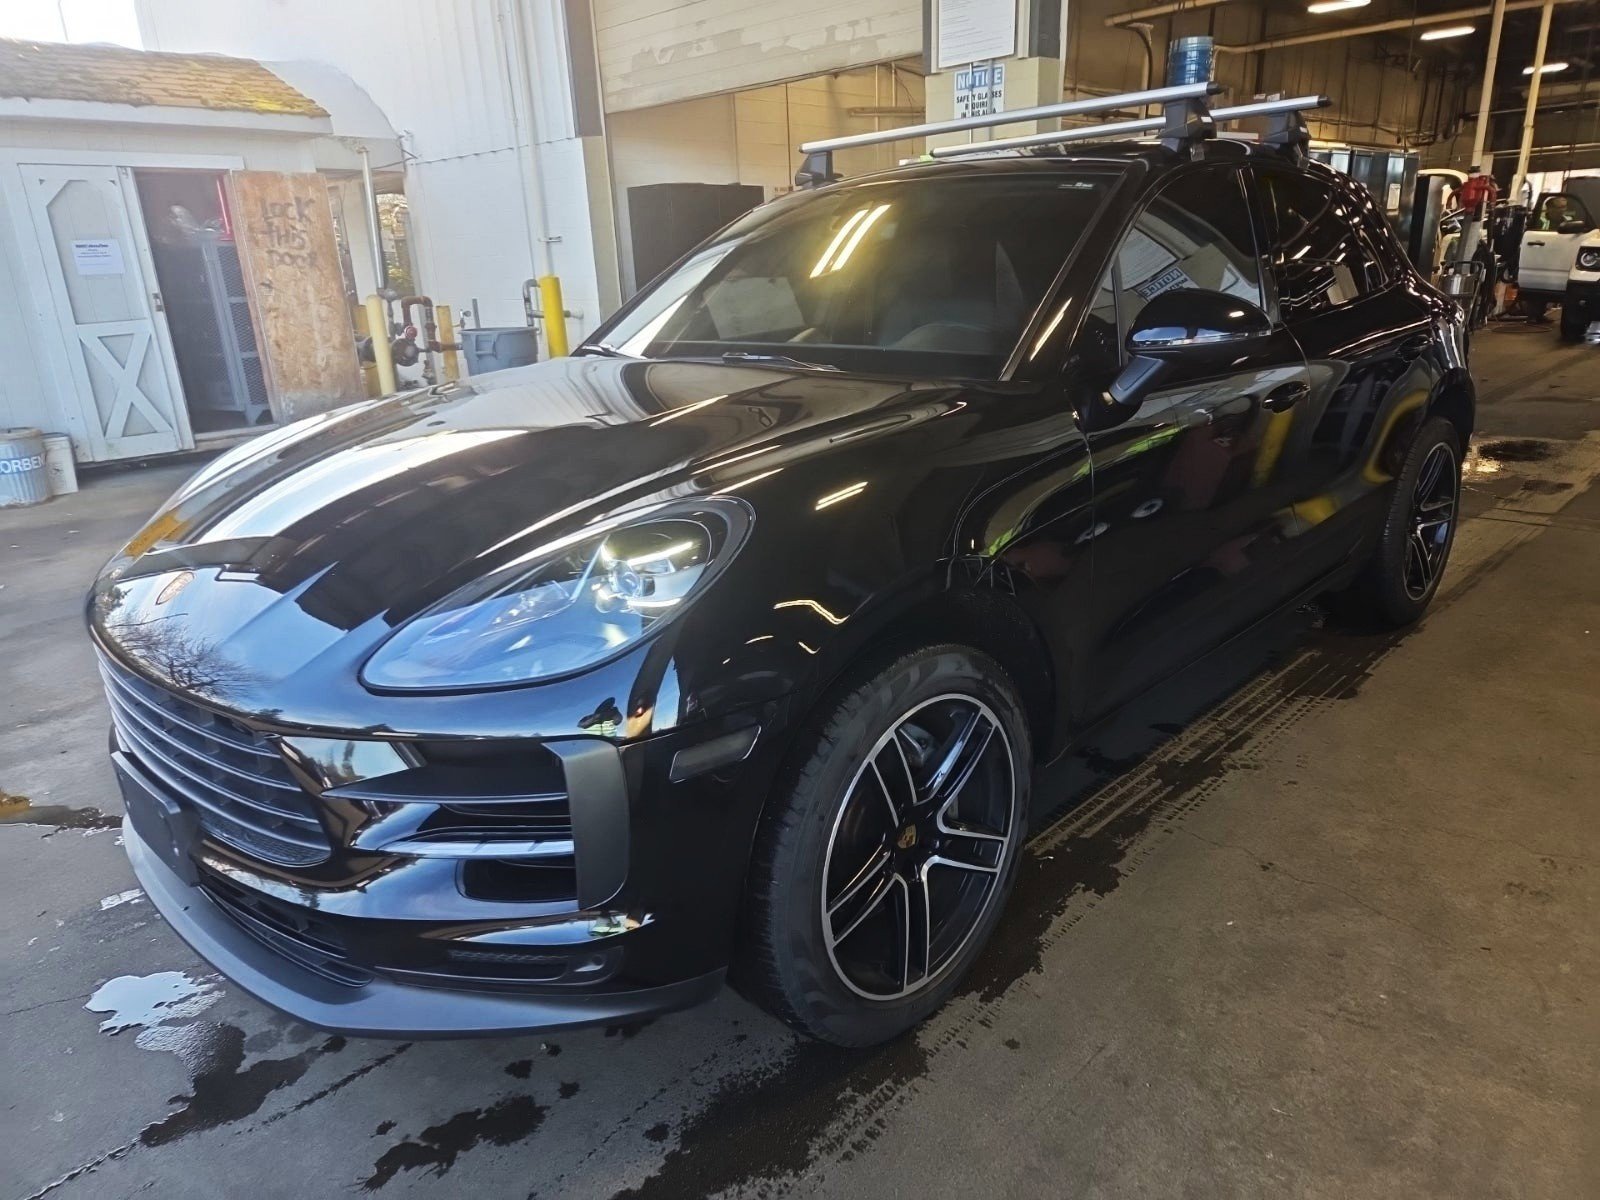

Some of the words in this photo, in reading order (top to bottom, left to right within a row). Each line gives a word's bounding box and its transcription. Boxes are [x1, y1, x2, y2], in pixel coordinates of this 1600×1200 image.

[956, 95, 976, 104] SAFEY
[977, 90, 1002, 100] GLASES
[964, 100, 988, 111] RQUIR
[261, 196, 315, 222] LOCK
[0, 455, 43, 474] ORBEN
